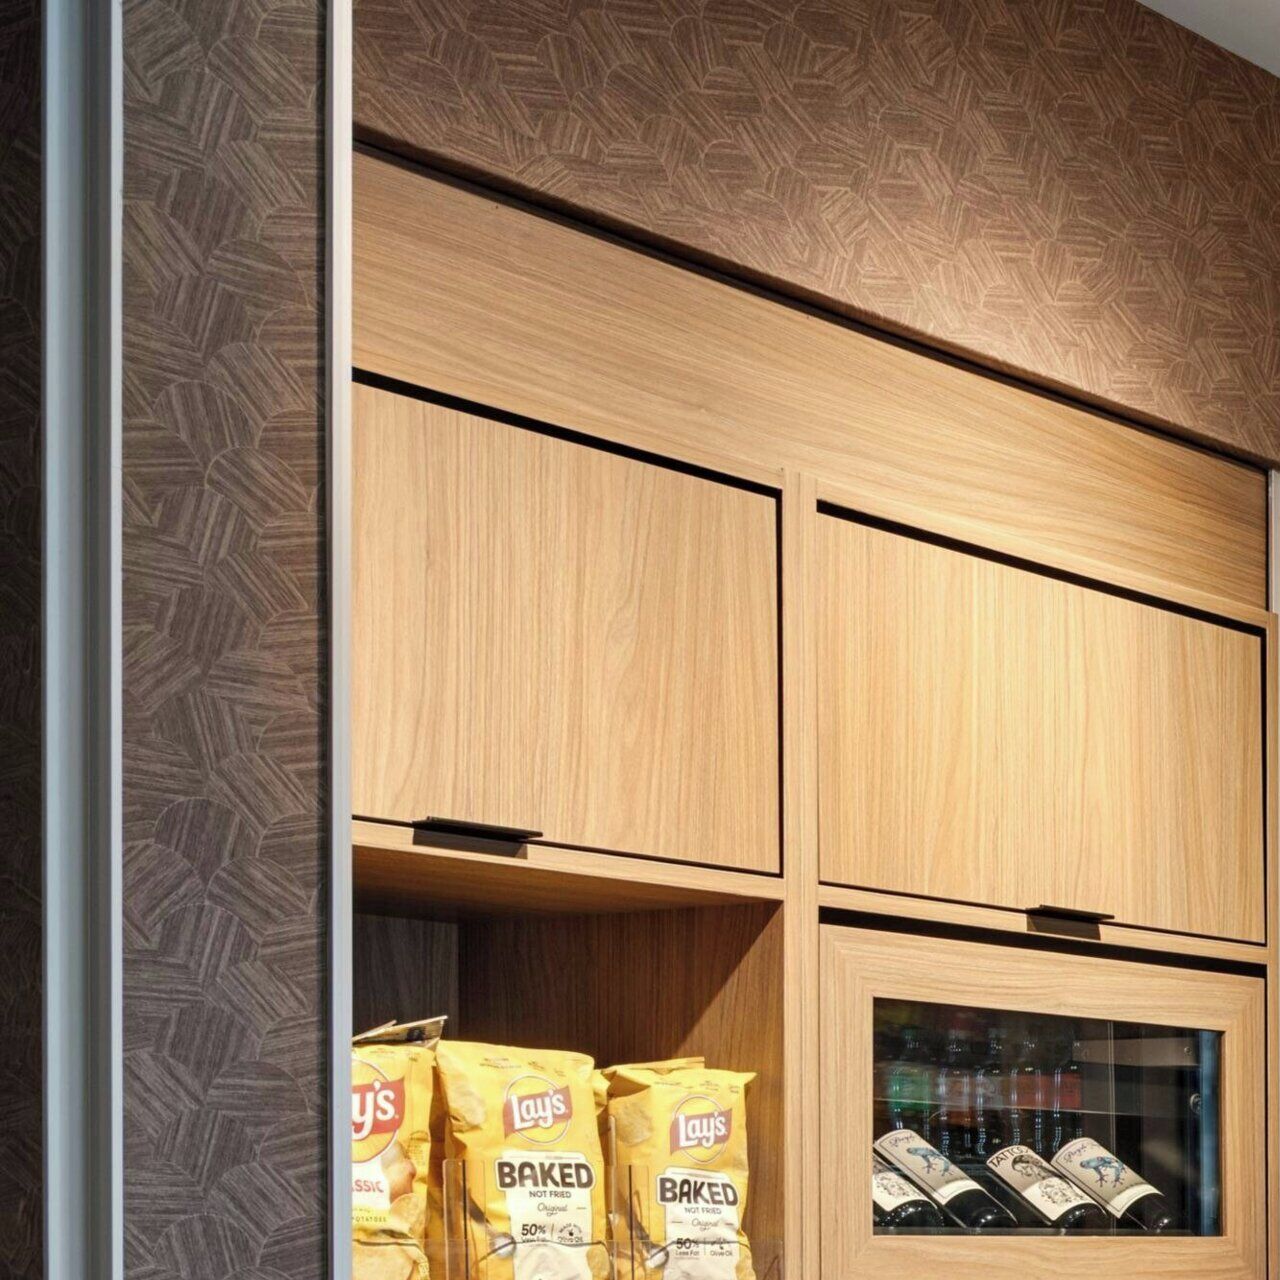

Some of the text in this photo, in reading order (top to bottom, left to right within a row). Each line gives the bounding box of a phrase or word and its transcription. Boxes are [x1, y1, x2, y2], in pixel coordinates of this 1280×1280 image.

[352, 1079, 397, 1142] y's
[510, 1088, 567, 1131] Lay's
[678, 1111, 727, 1147] Lay's
[497, 1161, 594, 1189] BAKED
[529, 1190, 572, 1199] NOT FRIED
[658, 1176, 738, 1207] BAKED
[684, 1207, 722, 1215] NOT FRIED
[521, 1223, 547, 1237] 50%
